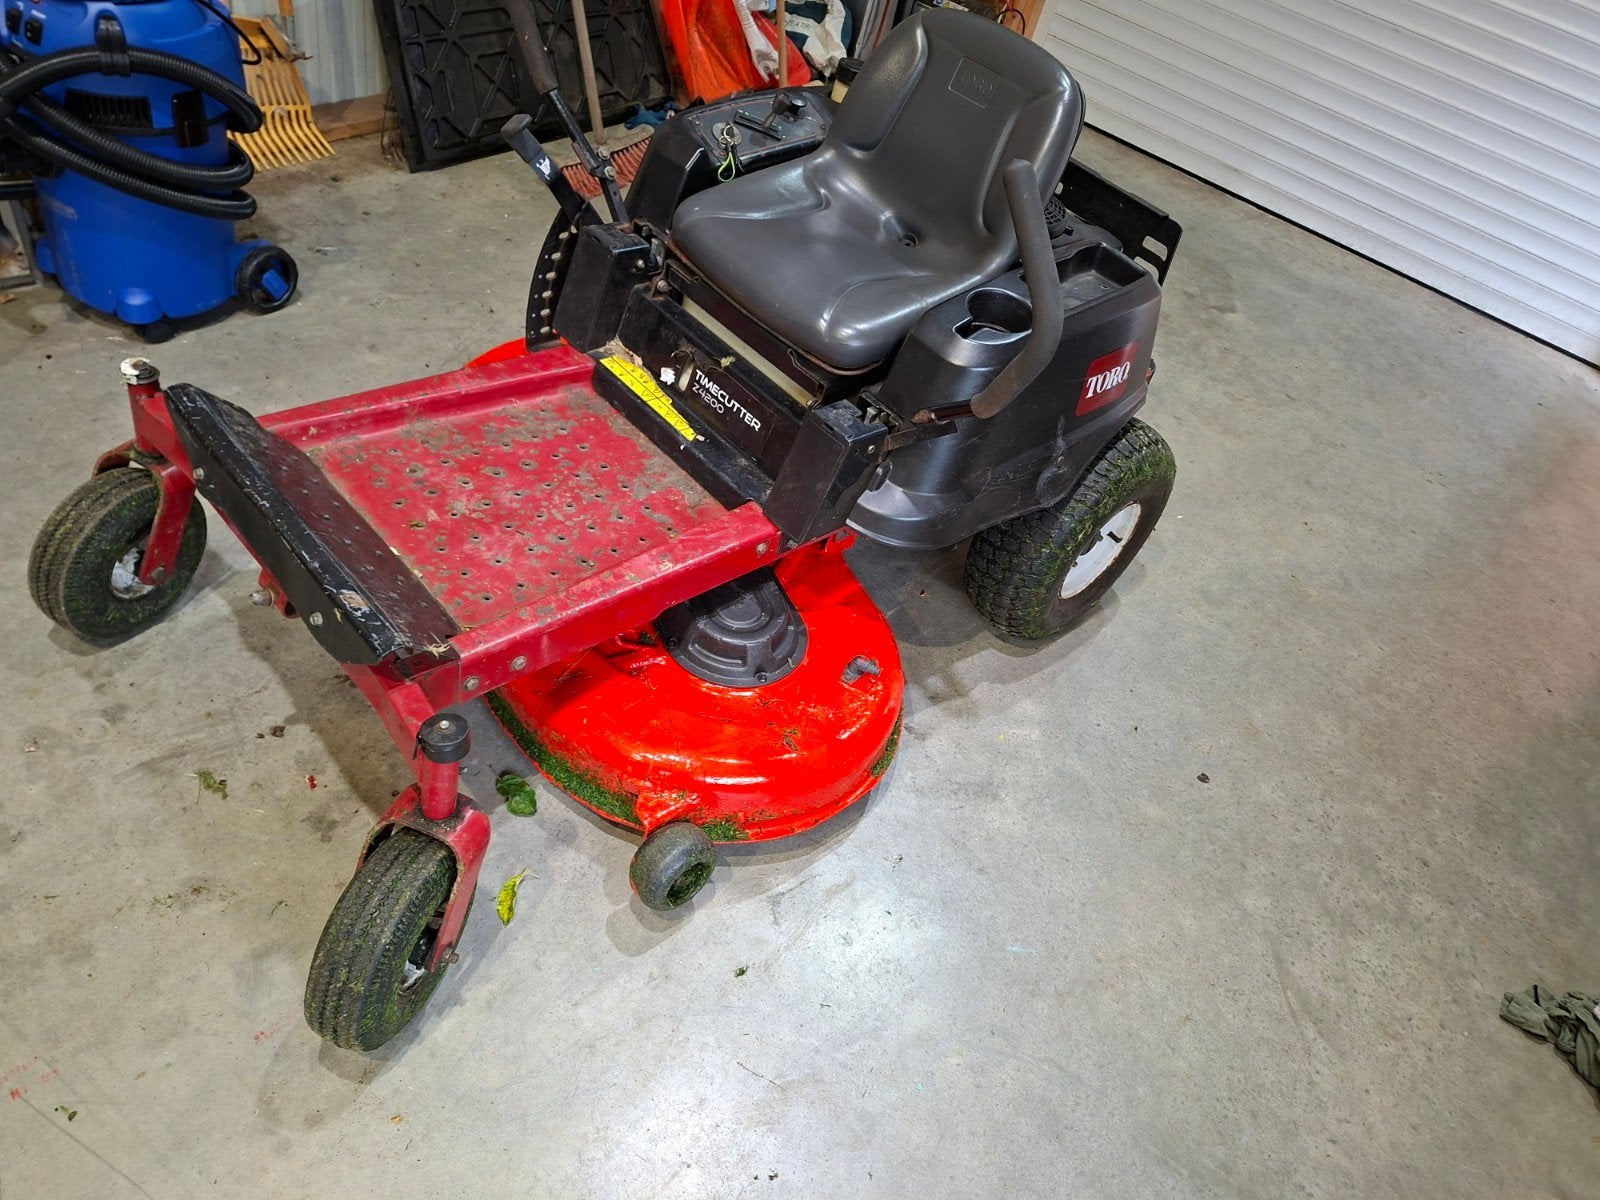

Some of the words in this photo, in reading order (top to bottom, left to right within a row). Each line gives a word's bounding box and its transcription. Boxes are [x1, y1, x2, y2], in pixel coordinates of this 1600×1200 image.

[692, 382, 724, 414] Z4200
[1085, 361, 1130, 399] TORO
[695, 369, 762, 432] TIMECUTTER
